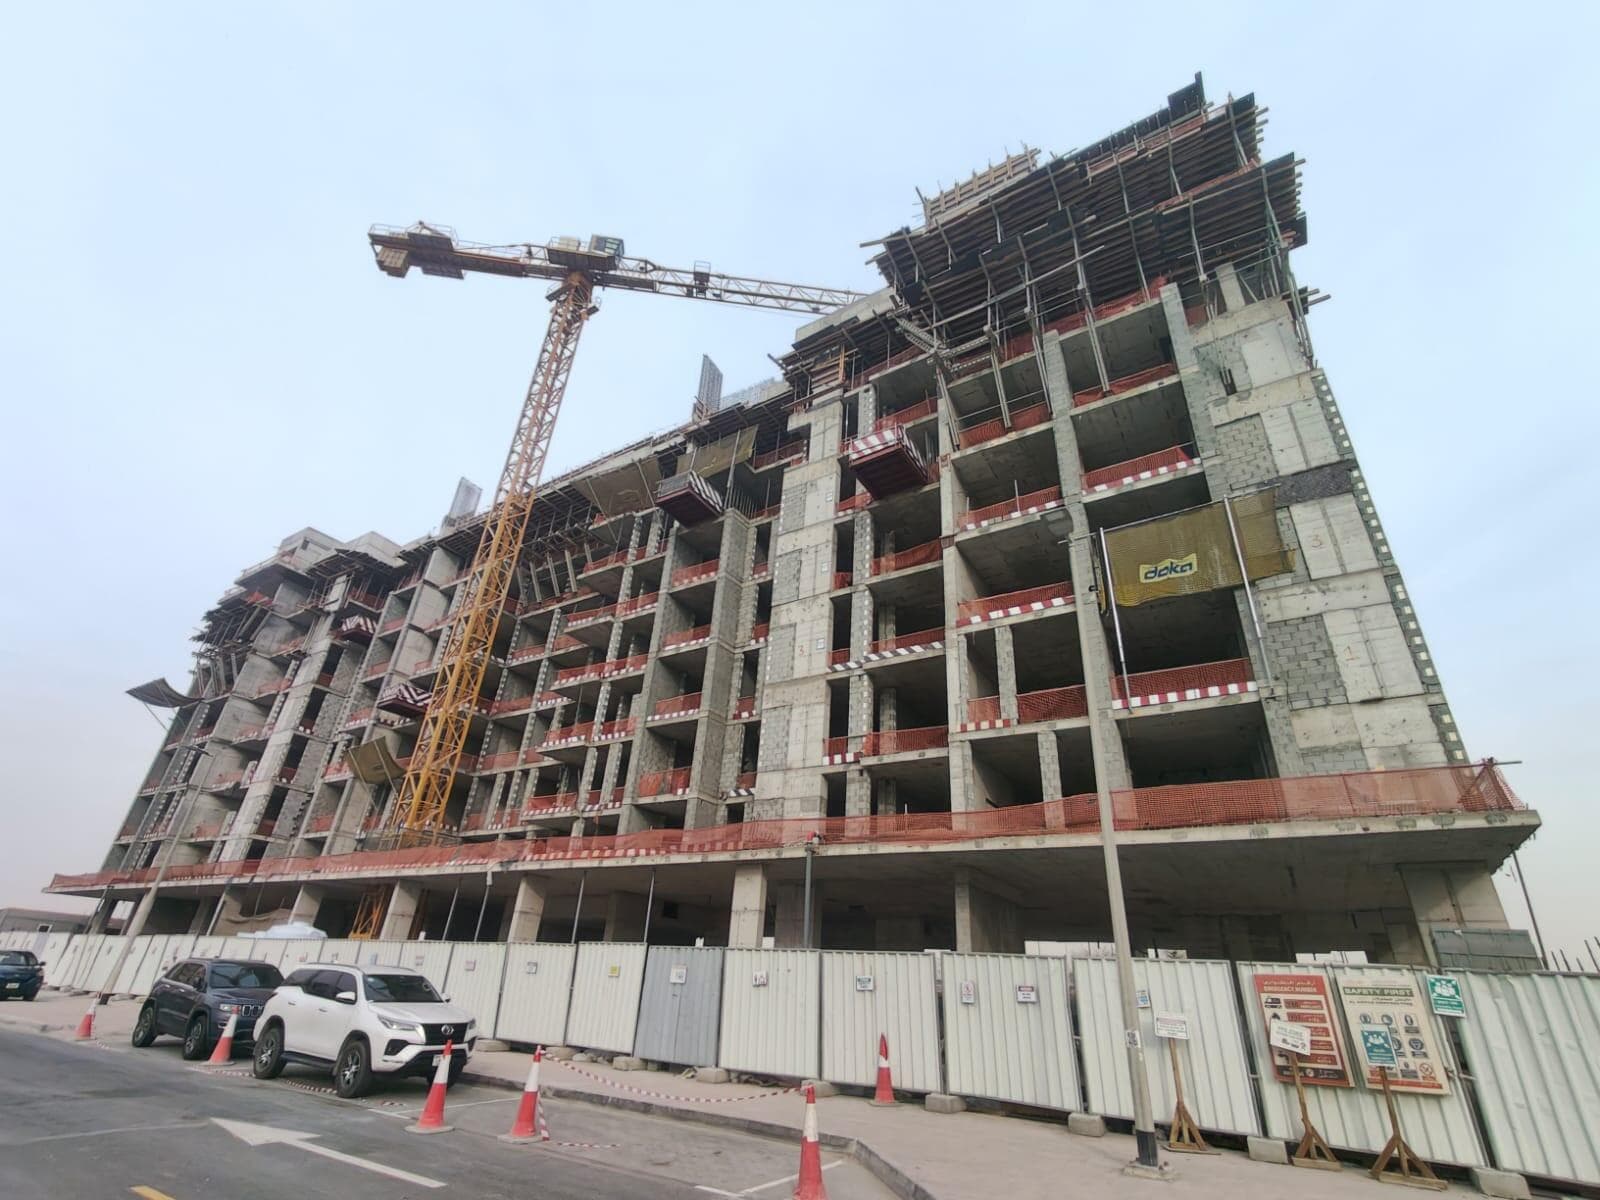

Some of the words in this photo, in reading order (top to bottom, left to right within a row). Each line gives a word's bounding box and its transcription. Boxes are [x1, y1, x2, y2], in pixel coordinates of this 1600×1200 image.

[1144, 562, 1192, 580] doka
[1344, 987, 1380, 995] SAFETY
[1383, 988, 1413, 996] FIRST
